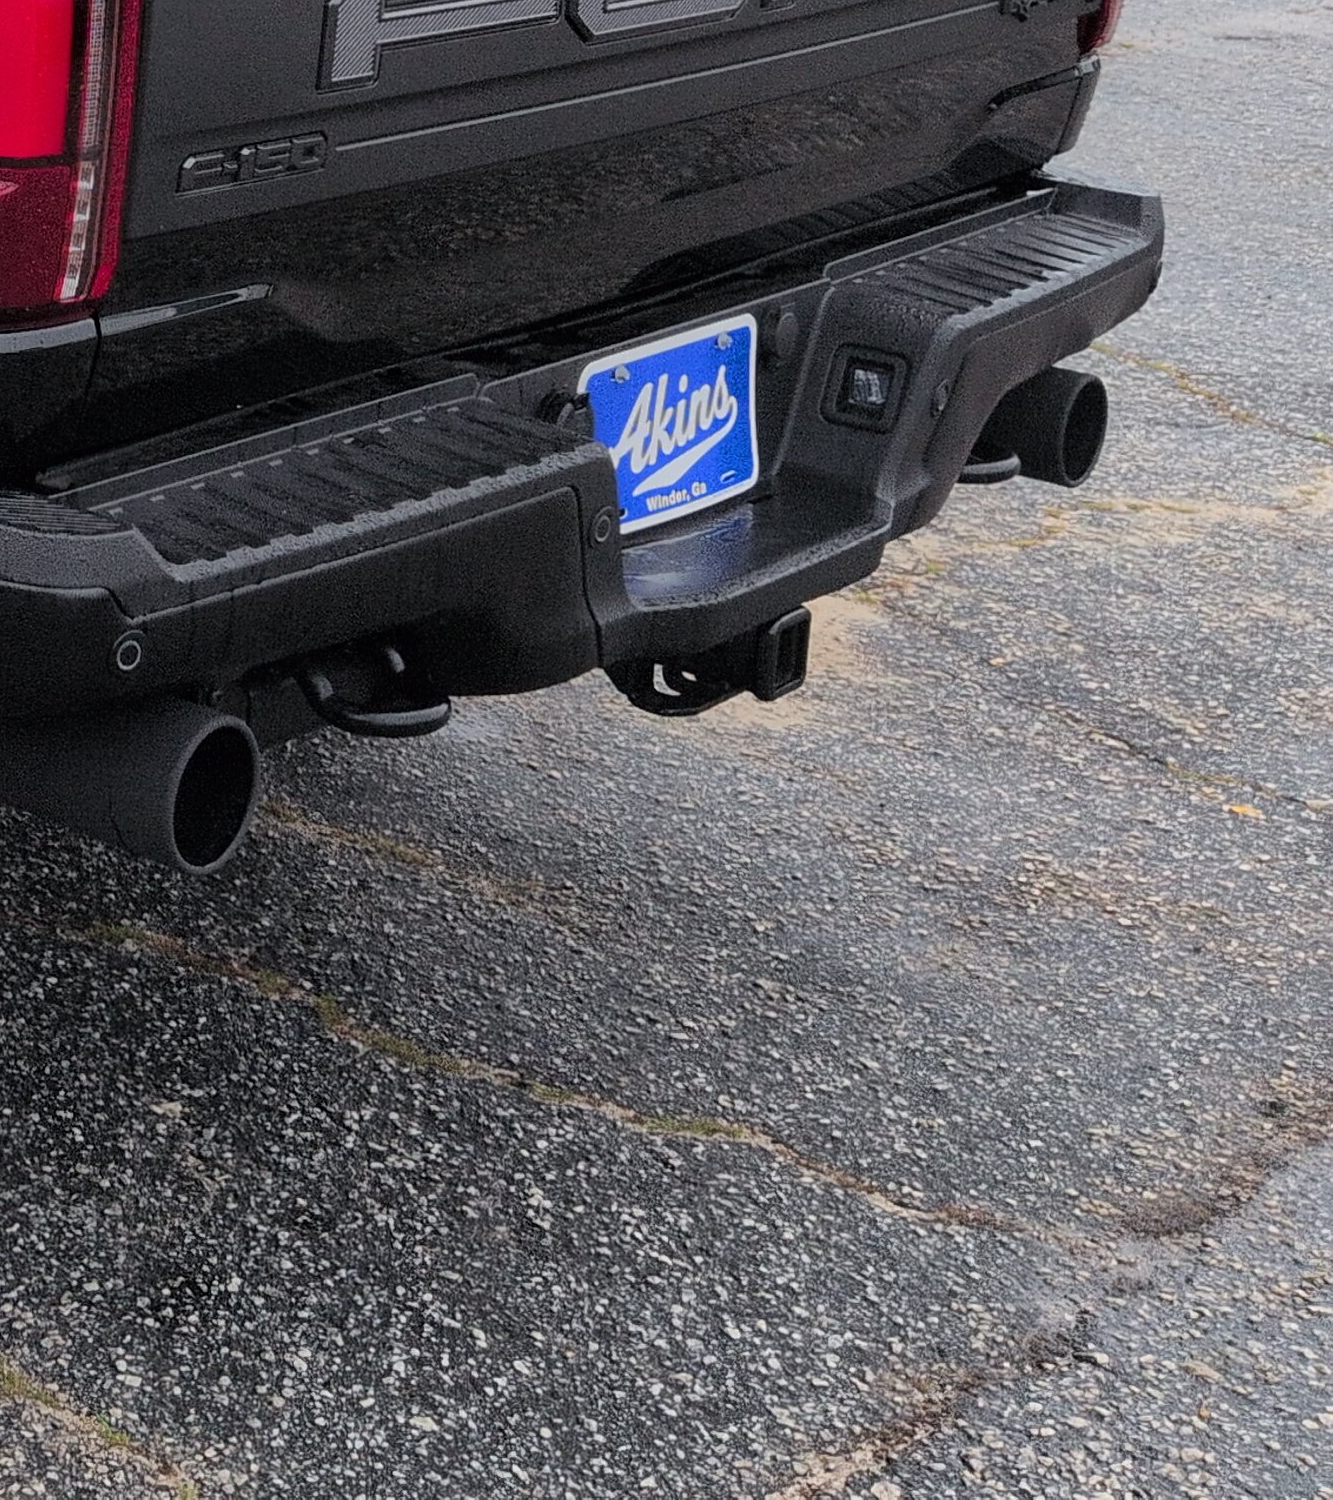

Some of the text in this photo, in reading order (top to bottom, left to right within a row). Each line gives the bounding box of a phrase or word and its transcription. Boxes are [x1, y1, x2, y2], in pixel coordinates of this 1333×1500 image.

[175, 130, 328, 197] F-150
[609, 364, 739, 480] Akins
[646, 481, 708, 512] Winder, Ga
